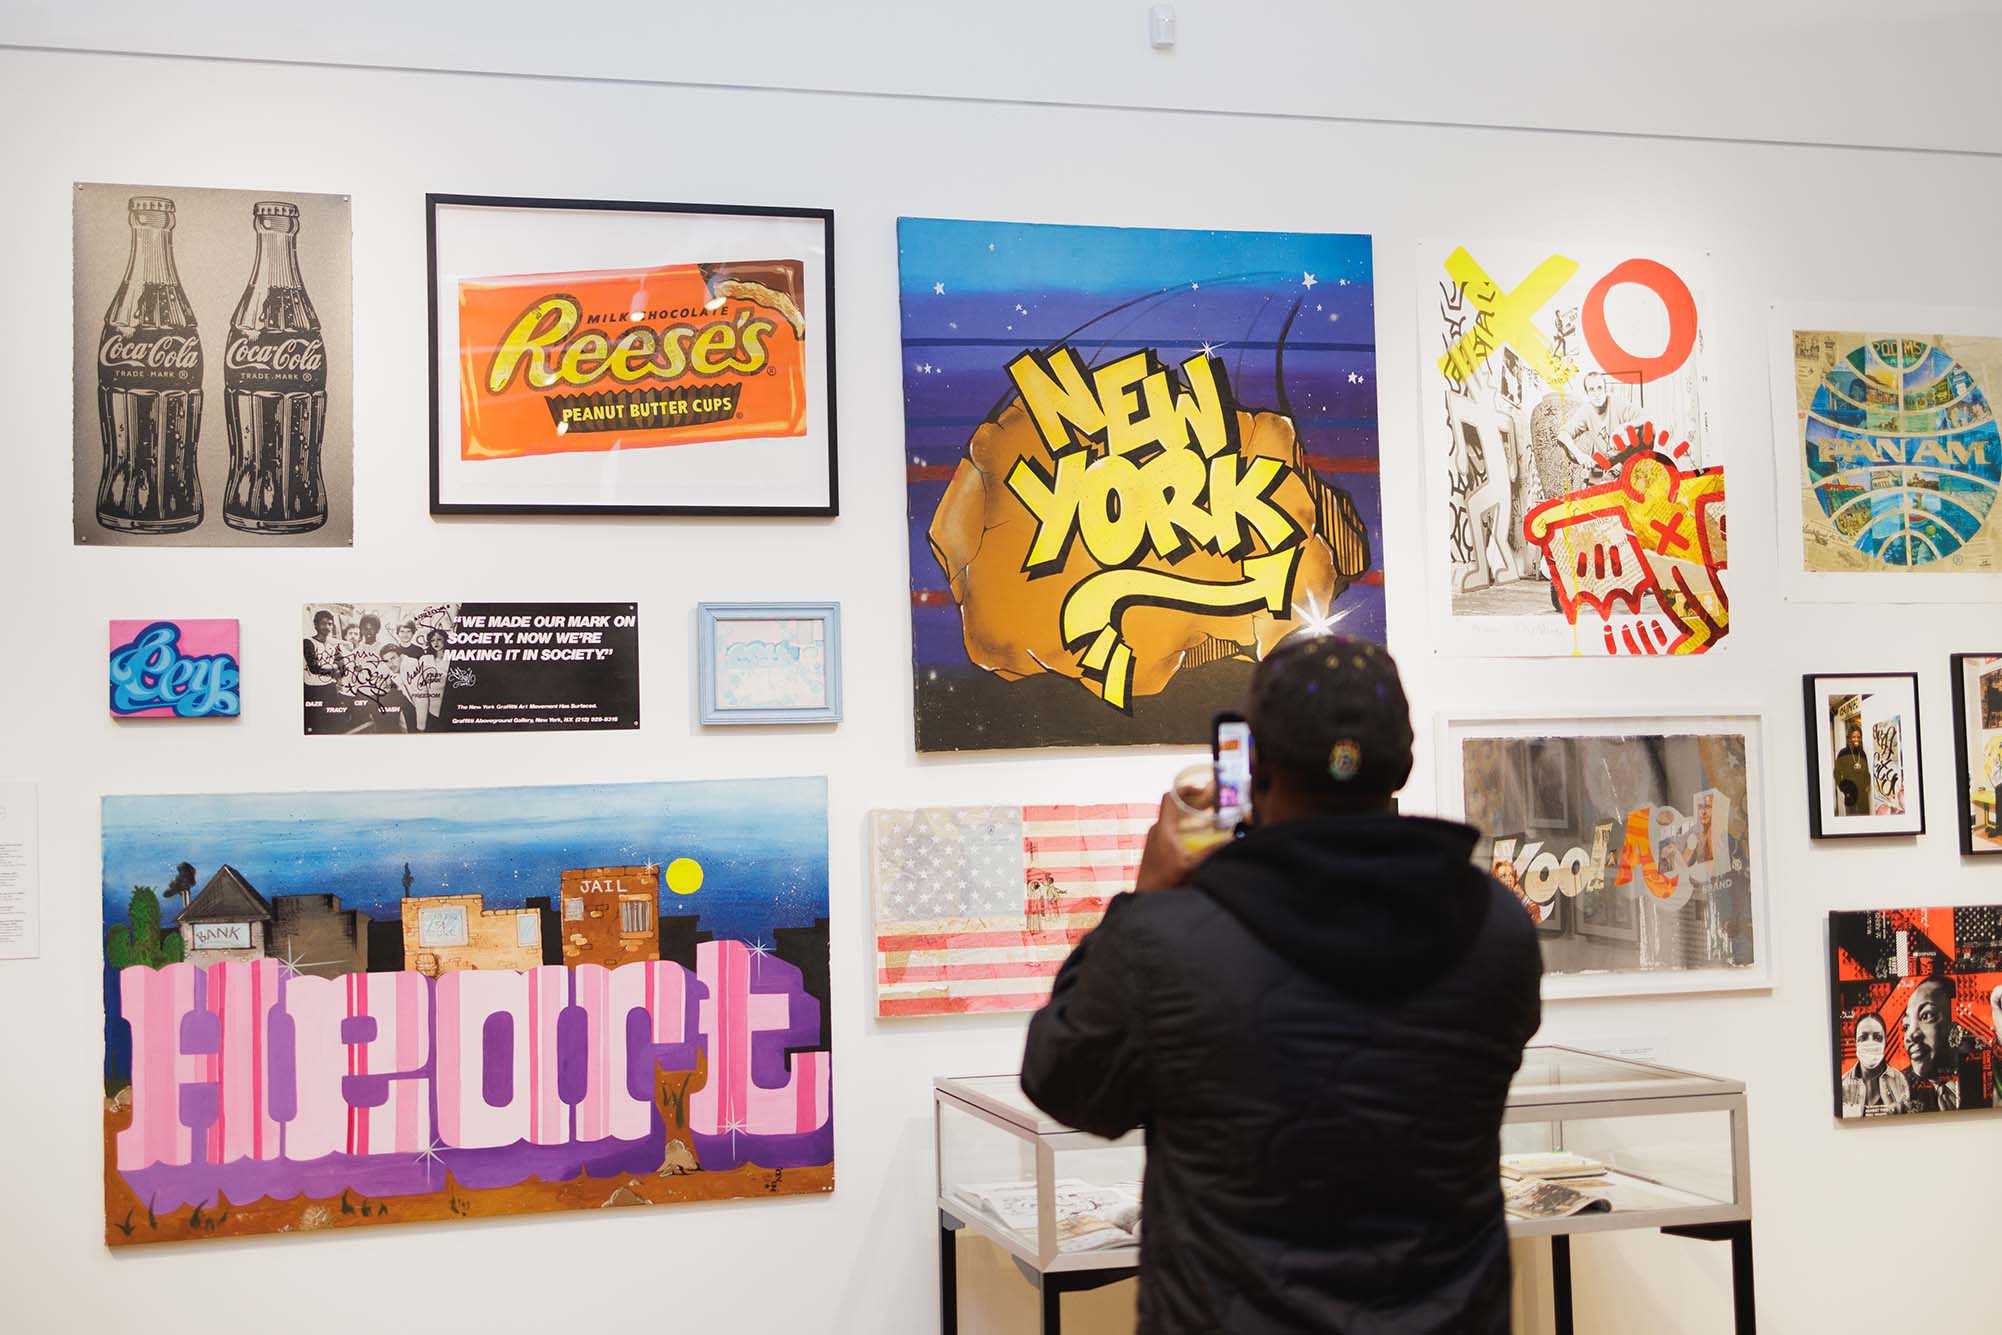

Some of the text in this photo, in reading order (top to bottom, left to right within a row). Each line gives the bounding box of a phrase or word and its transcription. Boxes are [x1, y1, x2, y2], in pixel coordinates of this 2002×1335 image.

[586, 306, 730, 325] MILK HOCOLATE
[100, 335, 199, 369] Coca-Cola
[226, 338, 323, 370] Coca-Cola
[486, 294, 778, 395] Reese's
[561, 397, 733, 423] PEANUT BUTTER CUPS
[1004, 346, 1236, 461] NEW
[1818, 438, 1992, 465] PAN AM
[1004, 449, 1305, 573] YORK
[487, 616, 532, 628] MADE
[533, 616, 566, 628] OUR
[567, 616, 611, 628] MARK
[613, 616, 636, 628] ON
[446, 631, 603, 645] SOCIETY. NOW WE'RE
[442, 649, 503, 661] MAKING
[505, 649, 521, 661] IT
[522, 649, 539, 661] IN
[580, 879, 628, 893] JAIL
[196, 926, 241, 943] BANK
